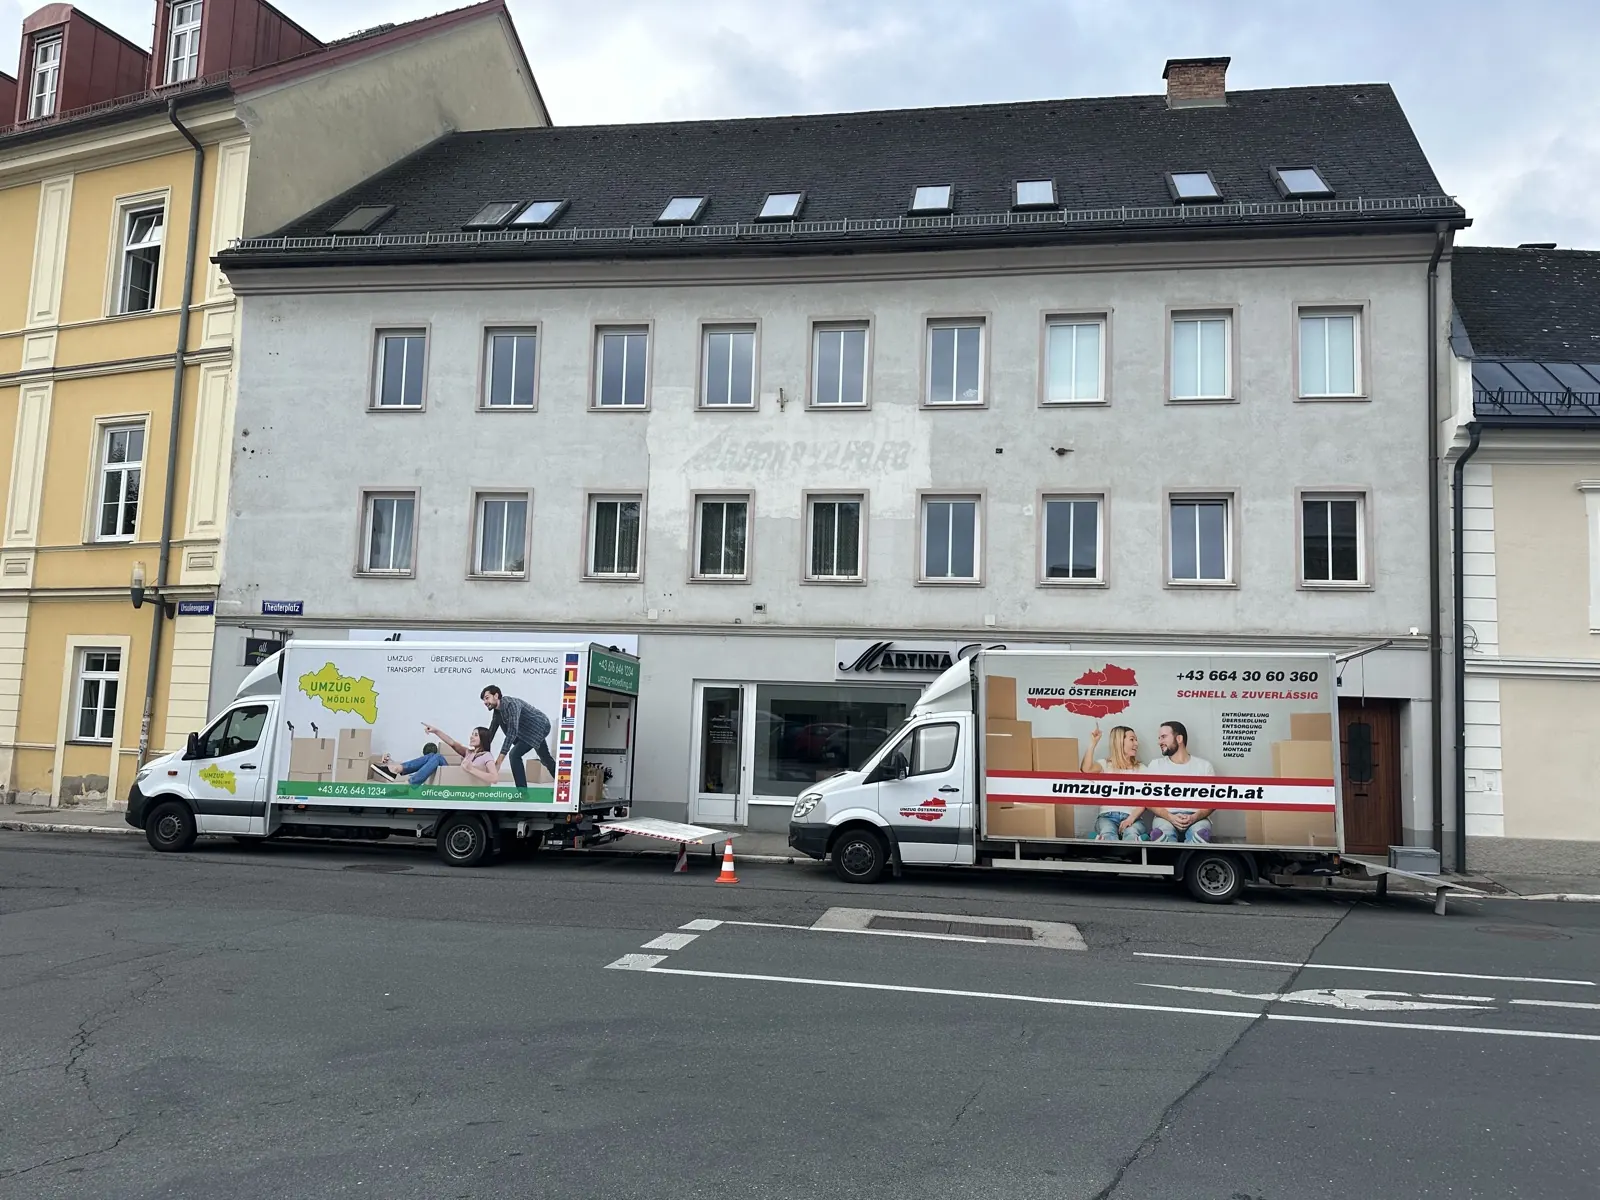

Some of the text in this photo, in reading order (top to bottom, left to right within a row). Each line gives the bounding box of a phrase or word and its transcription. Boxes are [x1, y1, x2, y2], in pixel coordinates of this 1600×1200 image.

[264, 603, 301, 613] Theaterplatz
[430, 655, 484, 663] ÜBERSIEDLUNG
[501, 655, 559, 664] ENTRÜMPELUNG
[838, 641, 953, 672] MARTINA
[1176, 670, 1319, 682] +43 664 30 60 360
[310, 681, 351, 692] UMZUG
[1028, 686, 1137, 697] UMZUG ÖSTERREICH
[326, 694, 366, 704] MÖDLING
[1176, 689, 1319, 700] SCHNELL & ZUVERLÄSSIG
[317, 785, 387, 795] +43 676 646 1234
[421, 788, 523, 800] office@umzug-moedling.at
[1051, 782, 1264, 800] umzug-in-österreich.at
